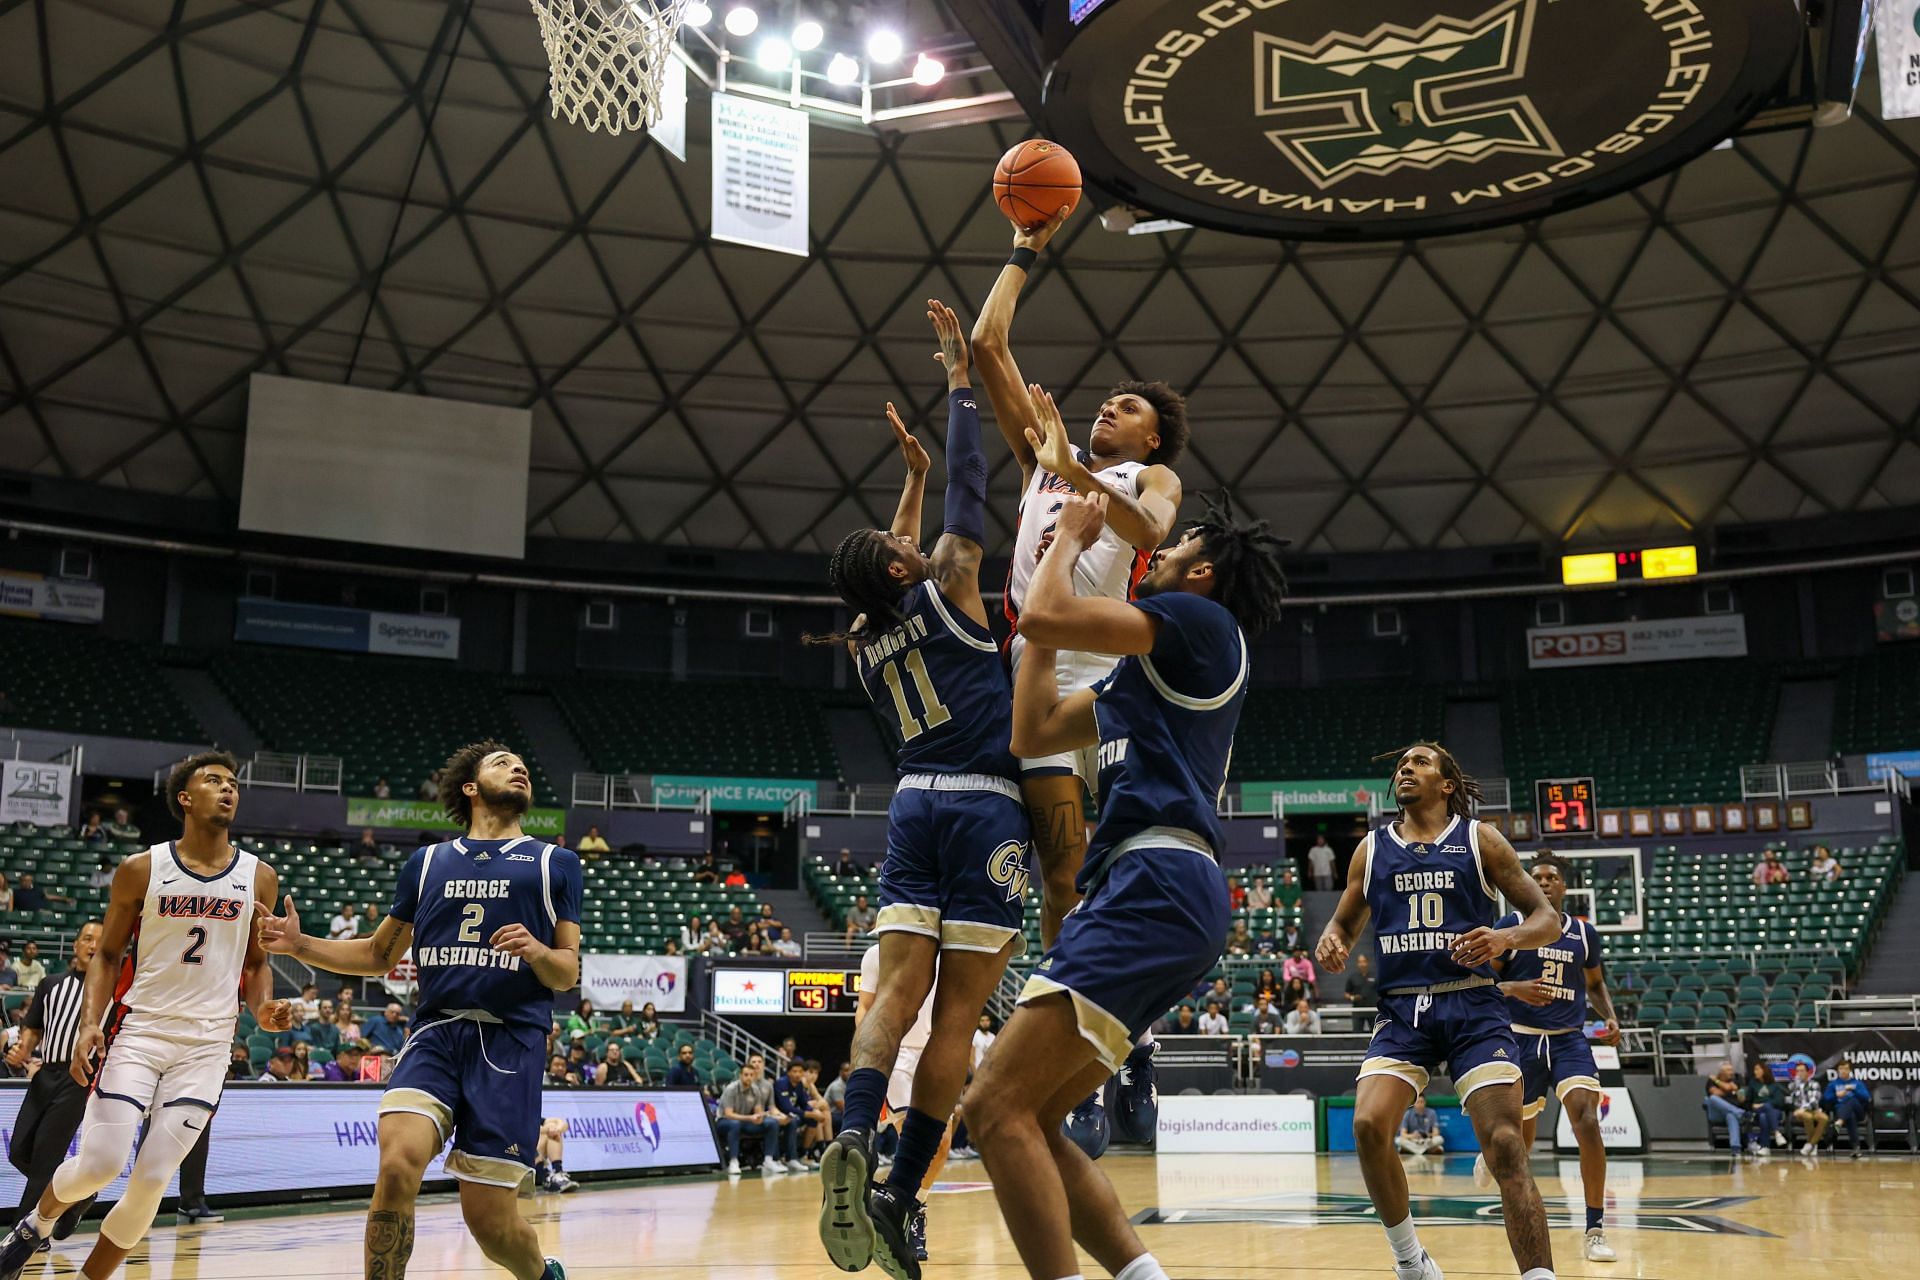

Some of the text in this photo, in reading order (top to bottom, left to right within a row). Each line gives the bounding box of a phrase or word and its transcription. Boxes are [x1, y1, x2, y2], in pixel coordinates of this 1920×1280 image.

[378, 622, 447, 641] Spectrum
[1534, 635, 1626, 657] PODS
[882, 647, 952, 742] 11
[16, 767, 59, 796] 25
[1549, 800, 1588, 830] 27
[443, 879, 511, 899] GEORGE
[1394, 870, 1455, 892] GEORGE
[158, 895, 244, 921] WAVES
[1408, 892, 1444, 930] 10
[457, 903, 486, 943] 2
[181, 926, 208, 966] 2
[1537, 946, 1575, 964] GEORGE
[418, 945, 522, 973] WASHINGTON
[591, 976, 654, 989] HAWAIIAN
[1541, 960, 1565, 986] 21
[714, 995, 782, 1006] Heineken
[800, 989, 824, 1008] 45
[1843, 1050, 1920, 1064] HAWAIIAN
[1827, 1067, 1904, 1081] DMOND
[1158, 1118, 1313, 1136] bigislandcandies.com
